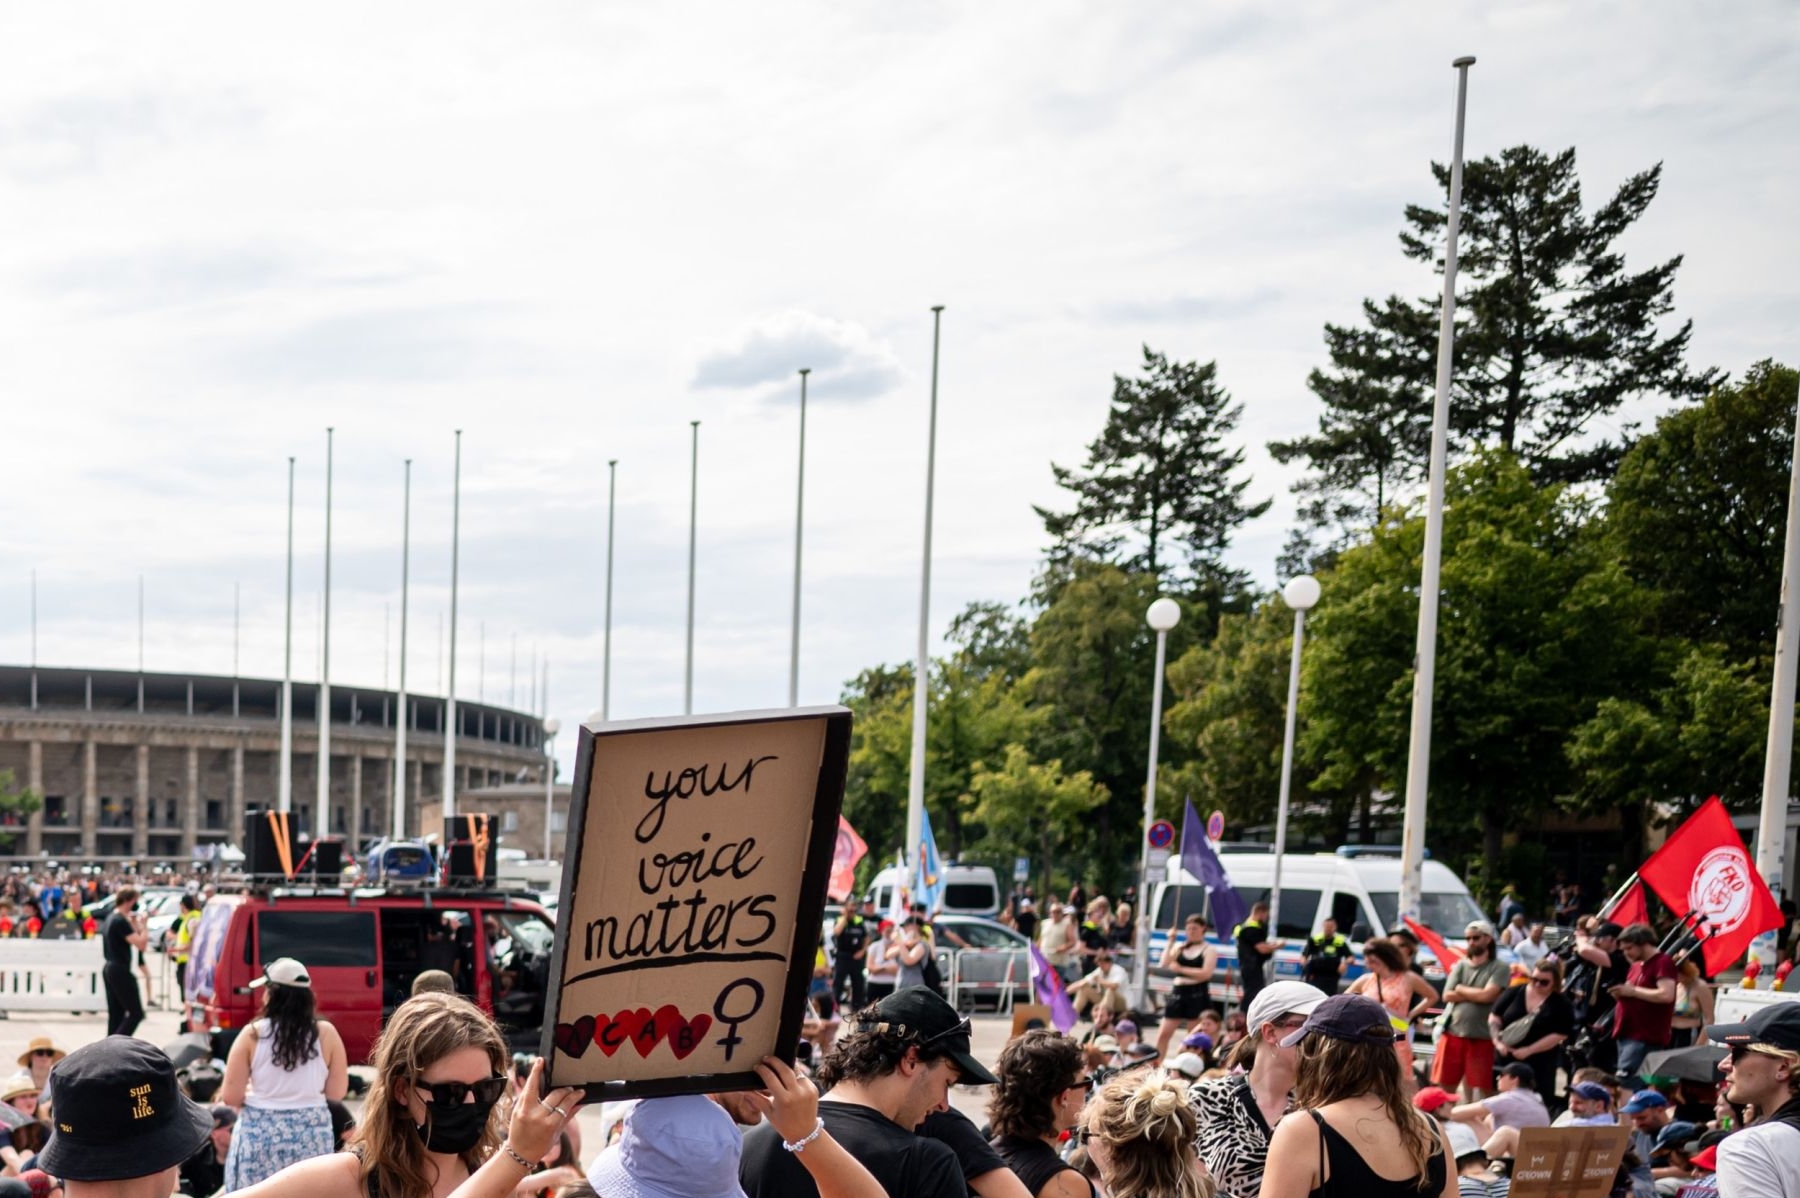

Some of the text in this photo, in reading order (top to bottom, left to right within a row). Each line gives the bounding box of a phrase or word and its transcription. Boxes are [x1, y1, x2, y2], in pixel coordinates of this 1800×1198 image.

[635, 755, 779, 844] your
[638, 832, 764, 895] voice
[585, 888, 777, 961] matters
[129, 1083, 152, 1098] sun
[137, 1095, 148, 1107] is
